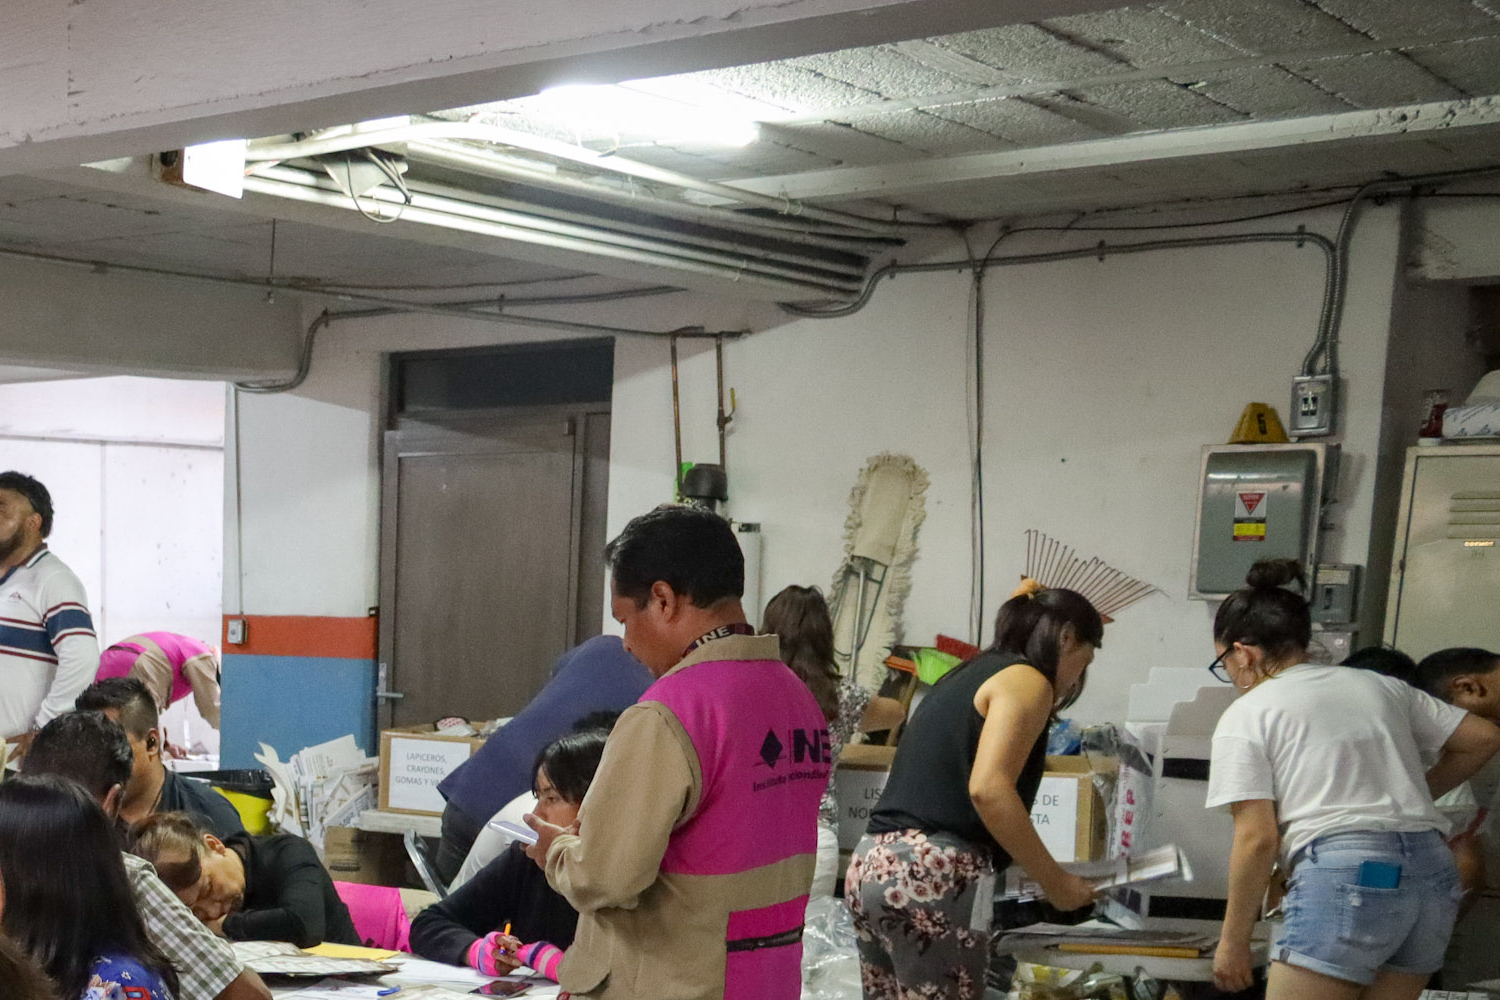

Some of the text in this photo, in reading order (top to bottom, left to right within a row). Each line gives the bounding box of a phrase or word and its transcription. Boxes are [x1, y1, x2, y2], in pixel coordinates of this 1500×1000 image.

[1257, 413, 1267, 435] 5
[695, 626, 731, 648] INE
[406, 752, 447, 764] LAPICEROS,
[406, 764, 446, 776] CRAYONES,
[395, 776, 423, 786] GOMAS
[424, 777, 430, 786] Y
[864, 788, 882, 800] LIS
[1043, 795, 1060, 806] DE
